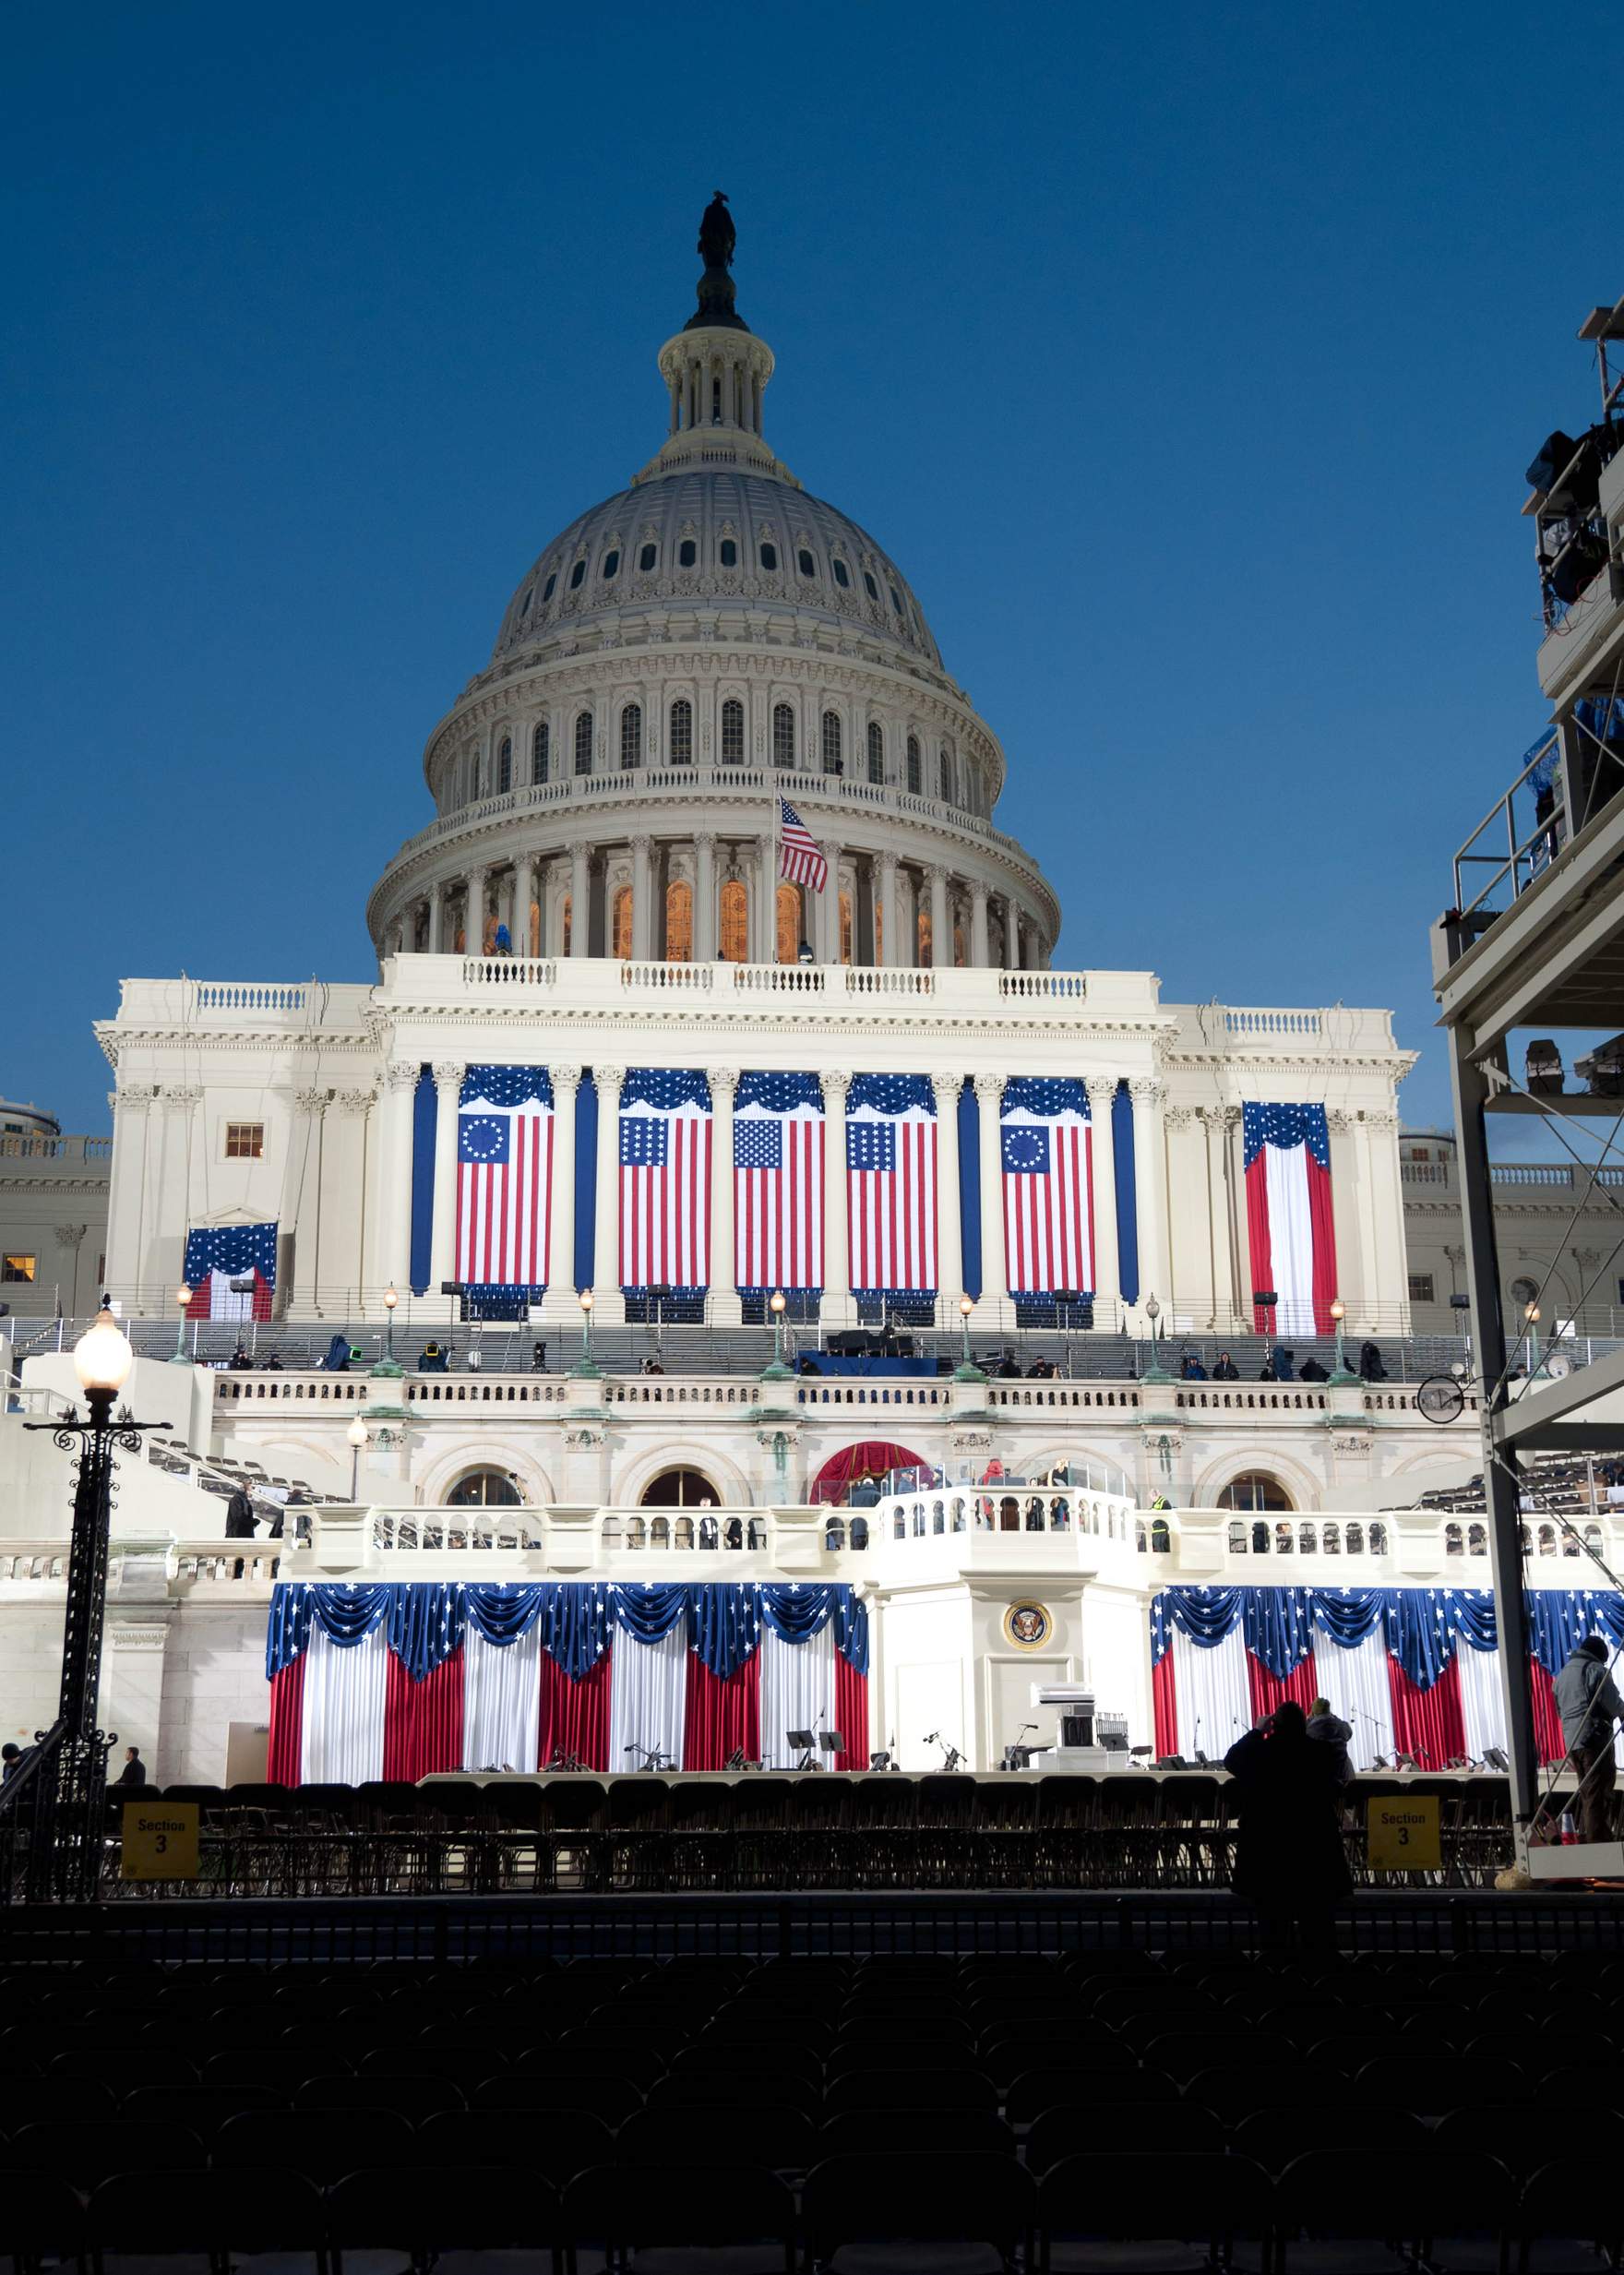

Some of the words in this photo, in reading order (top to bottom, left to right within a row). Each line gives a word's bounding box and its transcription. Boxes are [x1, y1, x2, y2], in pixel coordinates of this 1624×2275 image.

[138, 1819, 185, 1831] Section
[1381, 1813, 1426, 1824] Section
[1398, 1827, 1409, 1845] 3
[156, 1835, 166, 1853] 3
